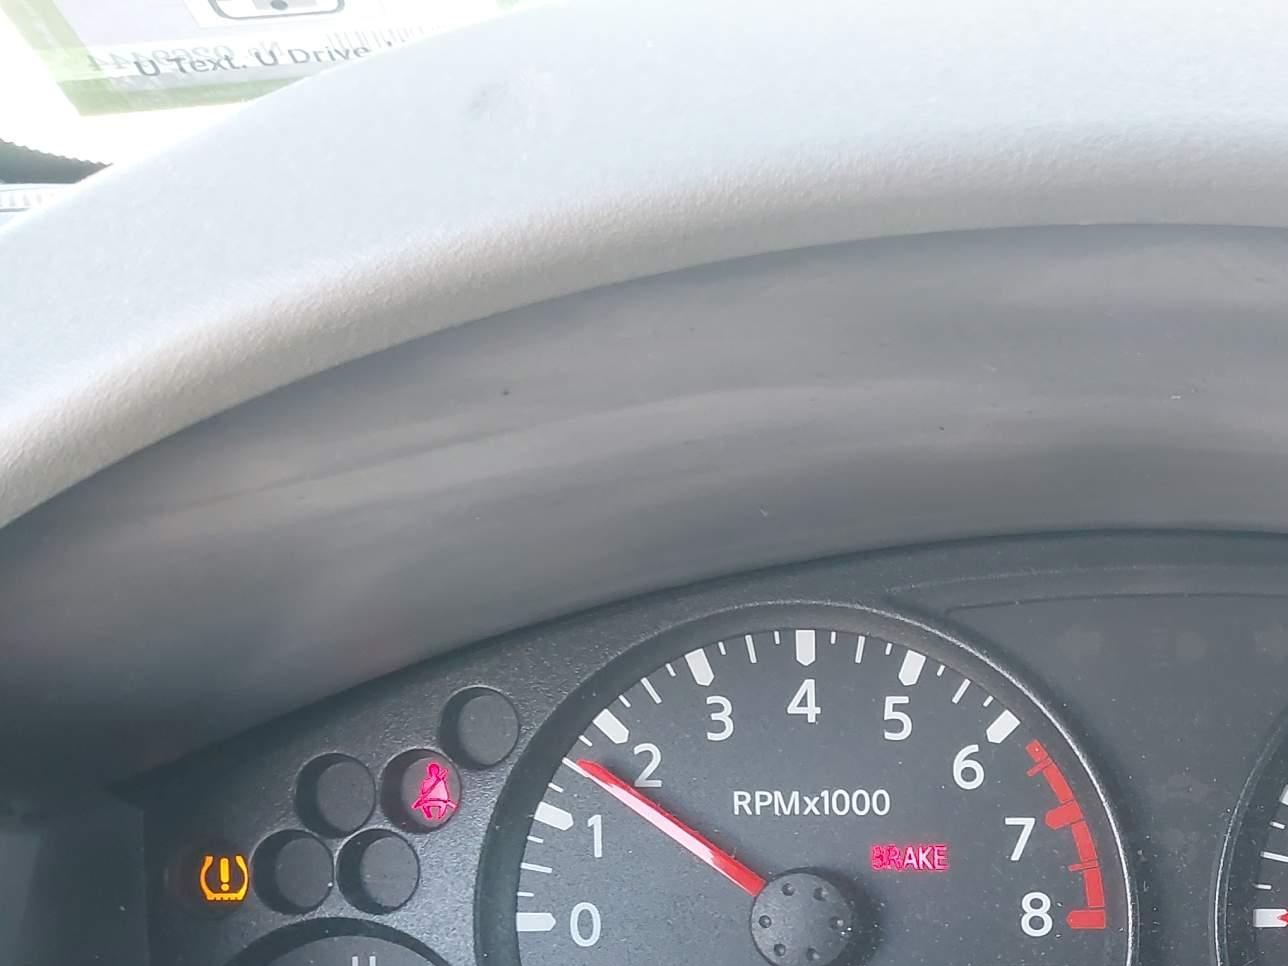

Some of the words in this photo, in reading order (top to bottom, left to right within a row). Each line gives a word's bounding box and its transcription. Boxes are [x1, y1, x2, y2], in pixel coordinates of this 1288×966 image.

[255, 50, 280, 67] U
[706, 695, 734, 741] 3
[787, 678, 821, 723] 4
[883, 695, 913, 741] 5
[633, 742, 663, 788] 2
[952, 744, 985, 790] 6
[733, 788, 891, 817] RPMx1000
[587, 814, 603, 858] 1
[871, 845, 949, 870] BRAKE
[1004, 817, 1036, 861] 7
[569, 901, 602, 947] 0
[1020, 891, 1053, 937] 8
